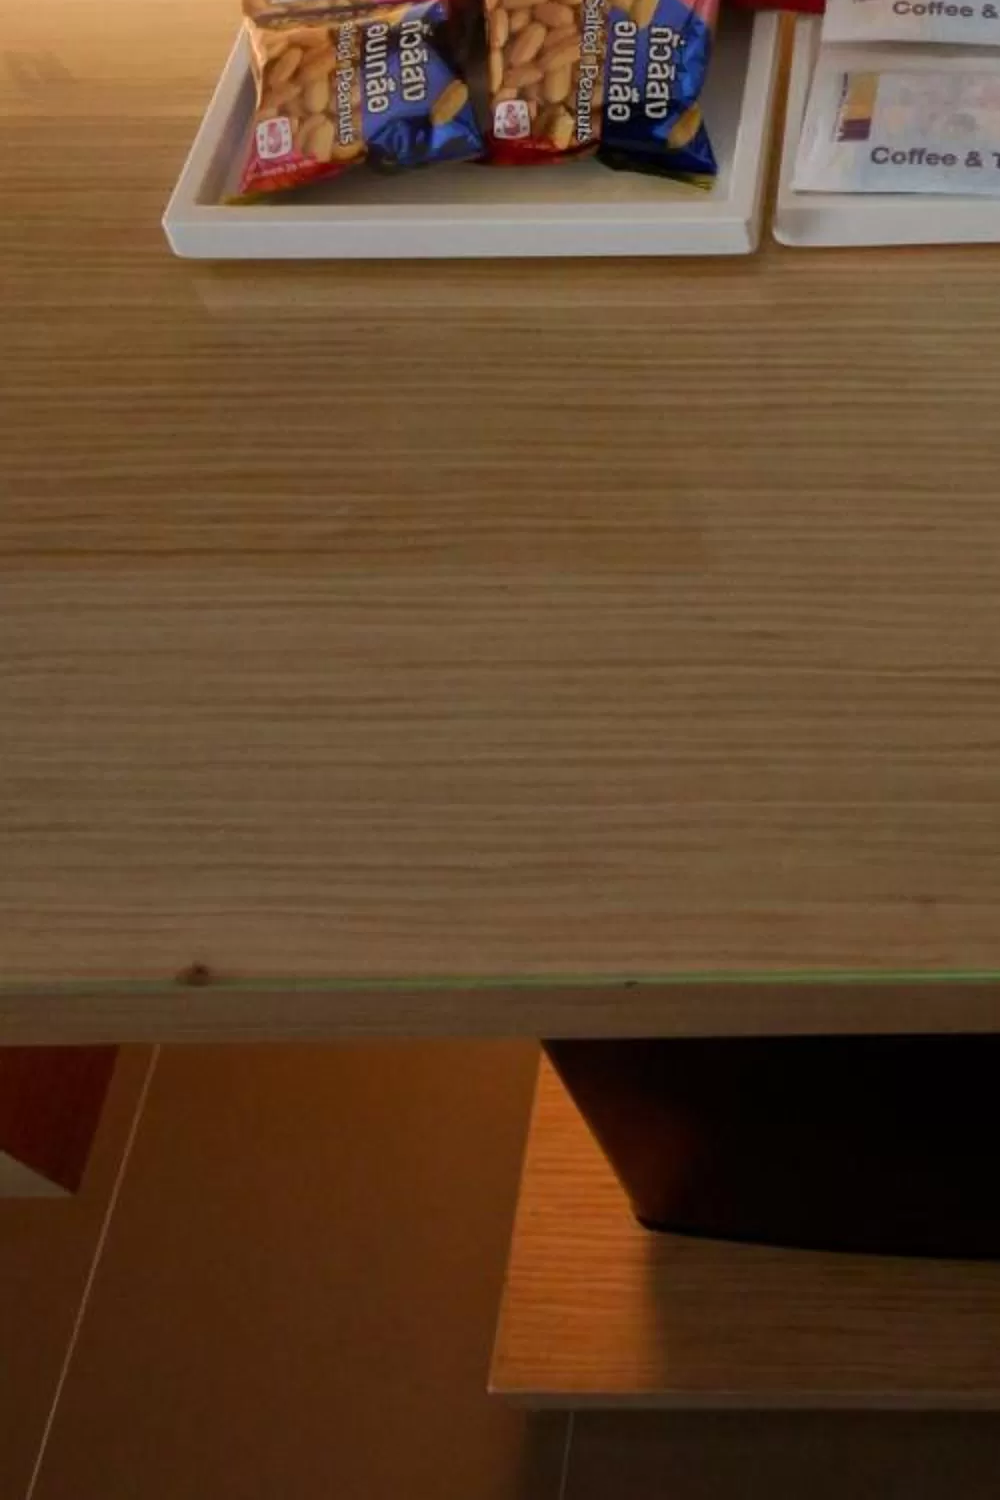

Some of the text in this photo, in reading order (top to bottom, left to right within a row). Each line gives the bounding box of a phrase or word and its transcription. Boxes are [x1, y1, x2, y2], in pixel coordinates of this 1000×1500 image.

[891, 0, 974, 19] Coffee
[981, 4, 999, 20] &
[365, 22, 396, 114] อบเกลือ
[400, 18, 433, 102] ถั่วลิสง
[607, 21, 640, 122] อบเกลือ
[645, 26, 686, 120] ถั่วลิสง
[338, 67, 354, 146] Peanuts
[575, 63, 599, 143] Peanuts
[870, 146, 958, 168] Coffee
[964, 150, 984, 169] &
